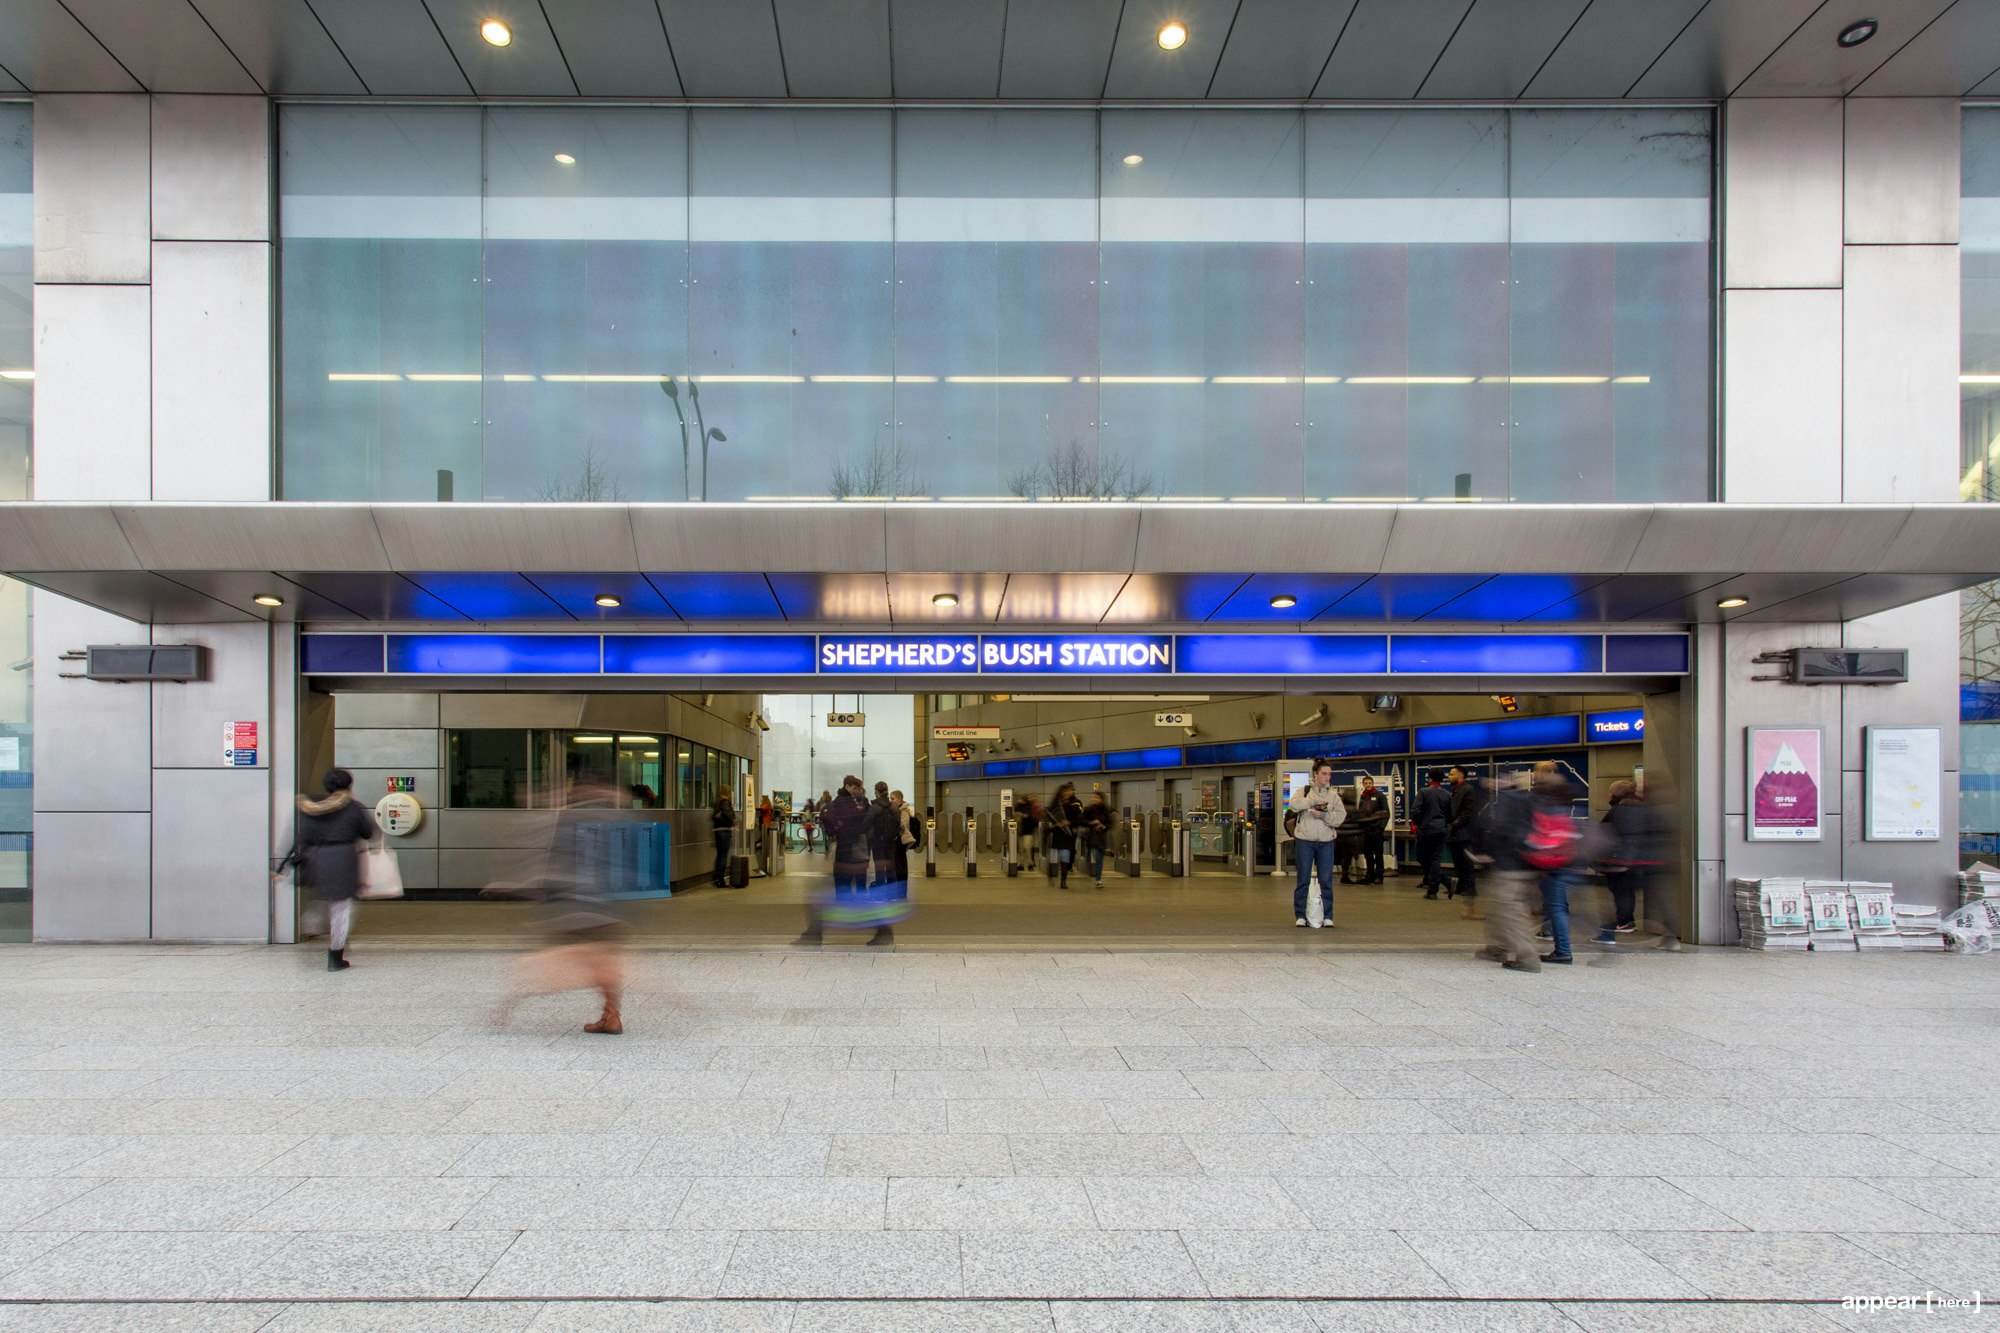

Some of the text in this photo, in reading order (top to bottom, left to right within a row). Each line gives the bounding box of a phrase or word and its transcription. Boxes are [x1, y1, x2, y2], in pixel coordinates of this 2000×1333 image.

[822, 643, 1169, 666] SHEPHERD'S BUSH STATION
[1594, 722, 1629, 732] Tickets
